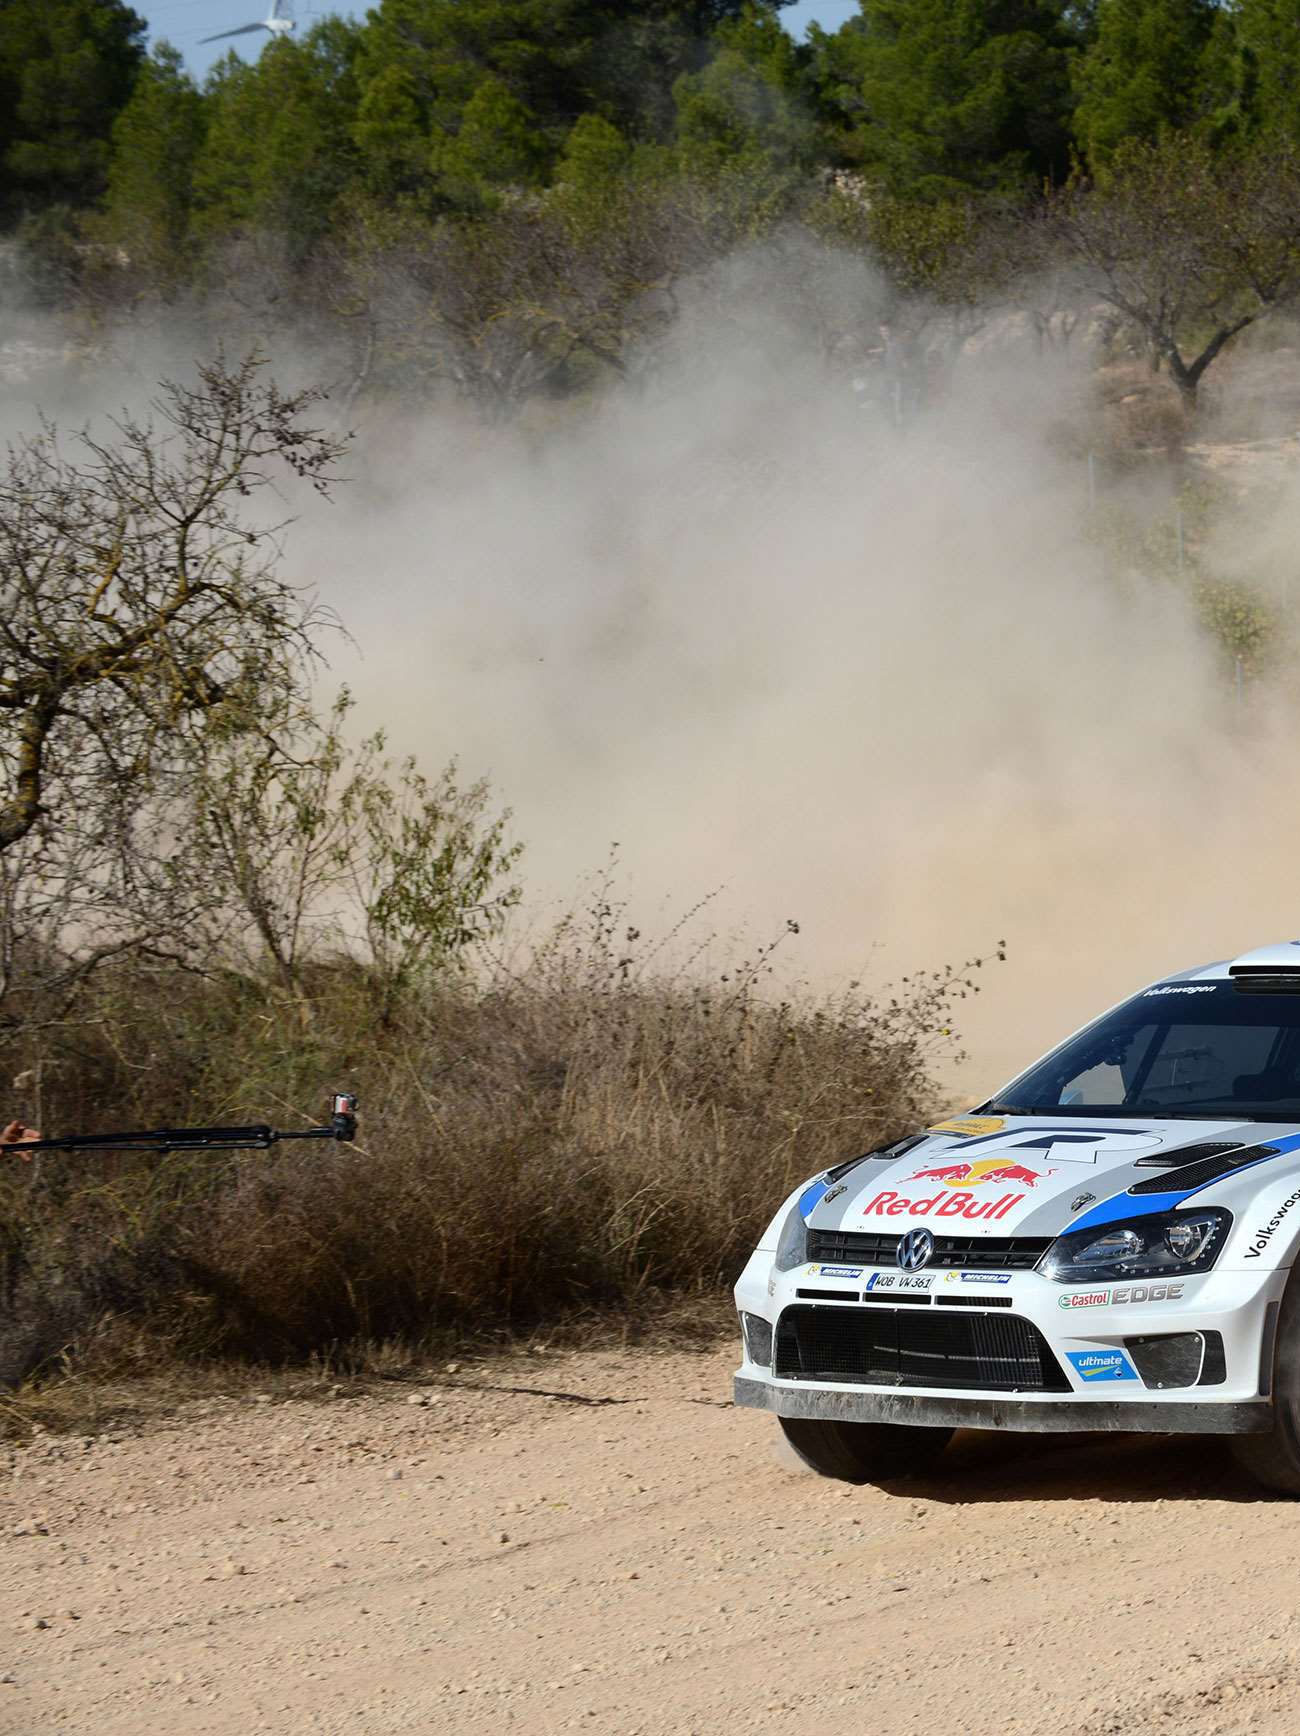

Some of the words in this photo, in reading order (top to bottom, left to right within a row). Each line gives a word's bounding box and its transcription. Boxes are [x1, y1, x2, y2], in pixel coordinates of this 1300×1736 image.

[1143, 985, 1217, 997] Volkswagen
[863, 1190, 941, 1217] Red
[935, 1192, 1026, 1220] Bull
[822, 1268, 863, 1278] MICHELIN
[963, 1274, 1012, 1283] MICHELIN
[875, 1276, 895, 1287] WOB
[1071, 1292, 1107, 1307] Castrol
[1112, 1283, 1185, 1304] EDGE
[1078, 1355, 1123, 1367] ultimate
